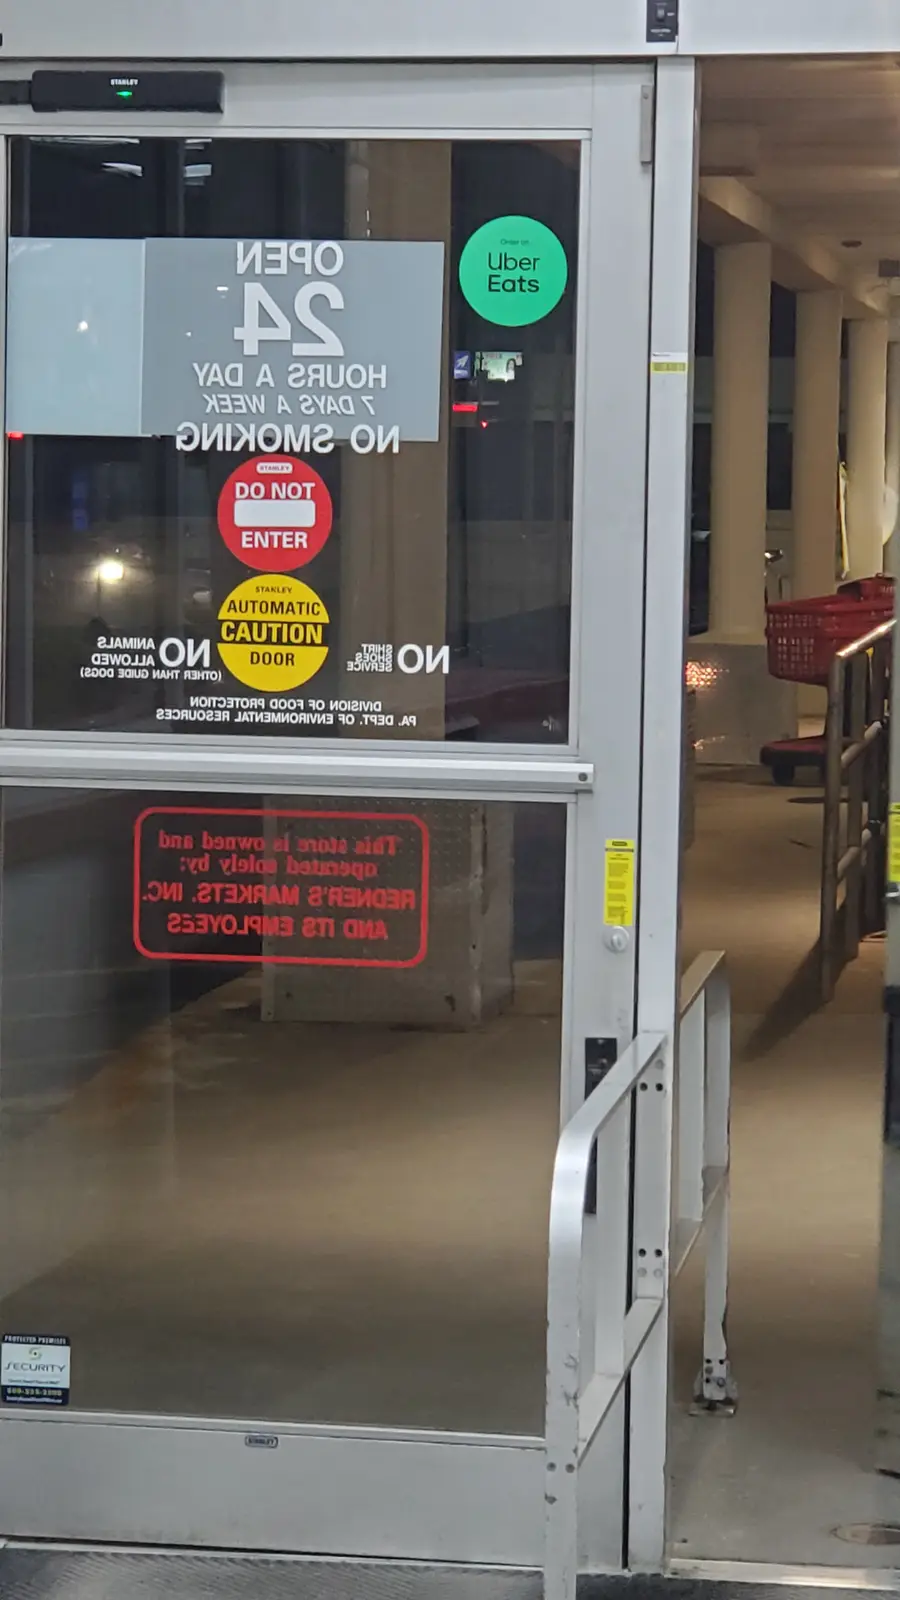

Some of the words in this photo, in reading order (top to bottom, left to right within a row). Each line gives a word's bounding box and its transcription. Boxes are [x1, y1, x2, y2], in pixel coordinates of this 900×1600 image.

[110, 78, 138, 86] STANLEY
[488, 252, 540, 271] Uber
[488, 275, 540, 293] Eats
[235, 482, 265, 500] DO
[271, 482, 315, 500] NOT
[241, 531, 308, 549] ENTER
[255, 586, 293, 594] STANLEY
[227, 599, 321, 616] AUTOMATIC
[220, 621, 323, 644] CAUTION
[250, 651, 295, 666] DOOR
[4, 1360, 66, 1373] SECURITY
